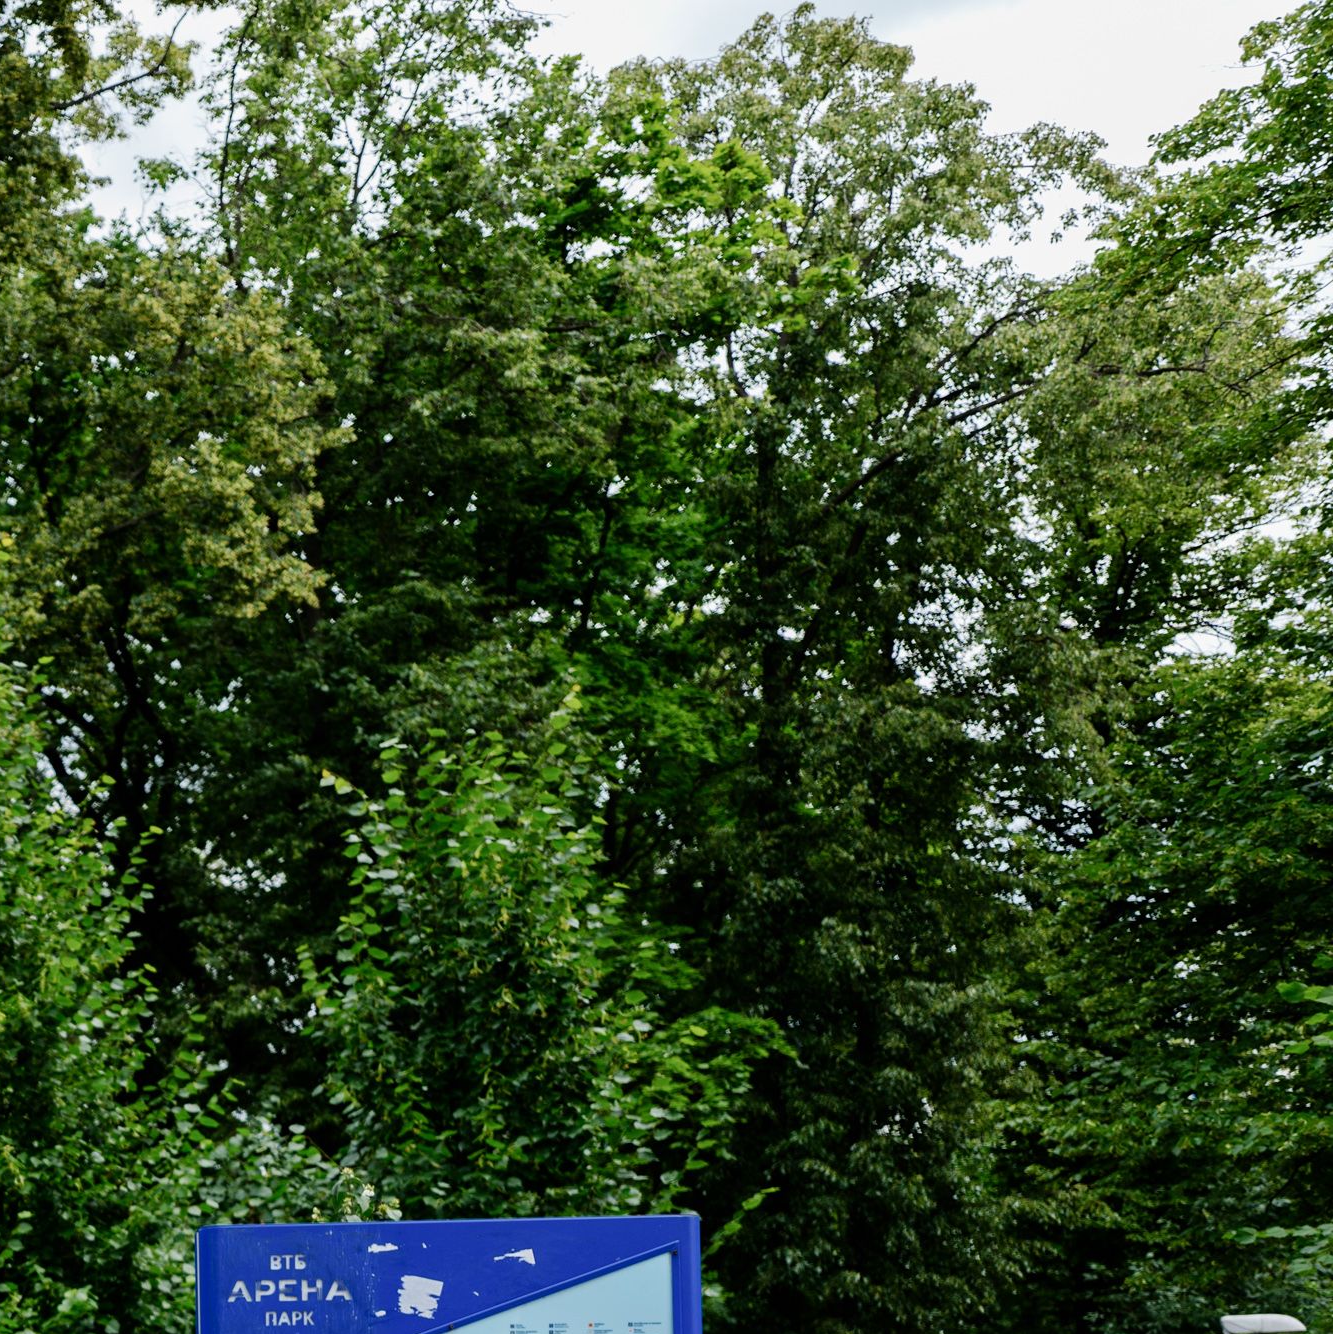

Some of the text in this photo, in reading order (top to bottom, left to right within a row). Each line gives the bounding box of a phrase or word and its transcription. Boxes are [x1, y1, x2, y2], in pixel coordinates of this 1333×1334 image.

[270, 1254, 307, 1271] ВТБ
[227, 1279, 353, 1303] АРЕНА
[265, 1311, 315, 1327] ПАРК
